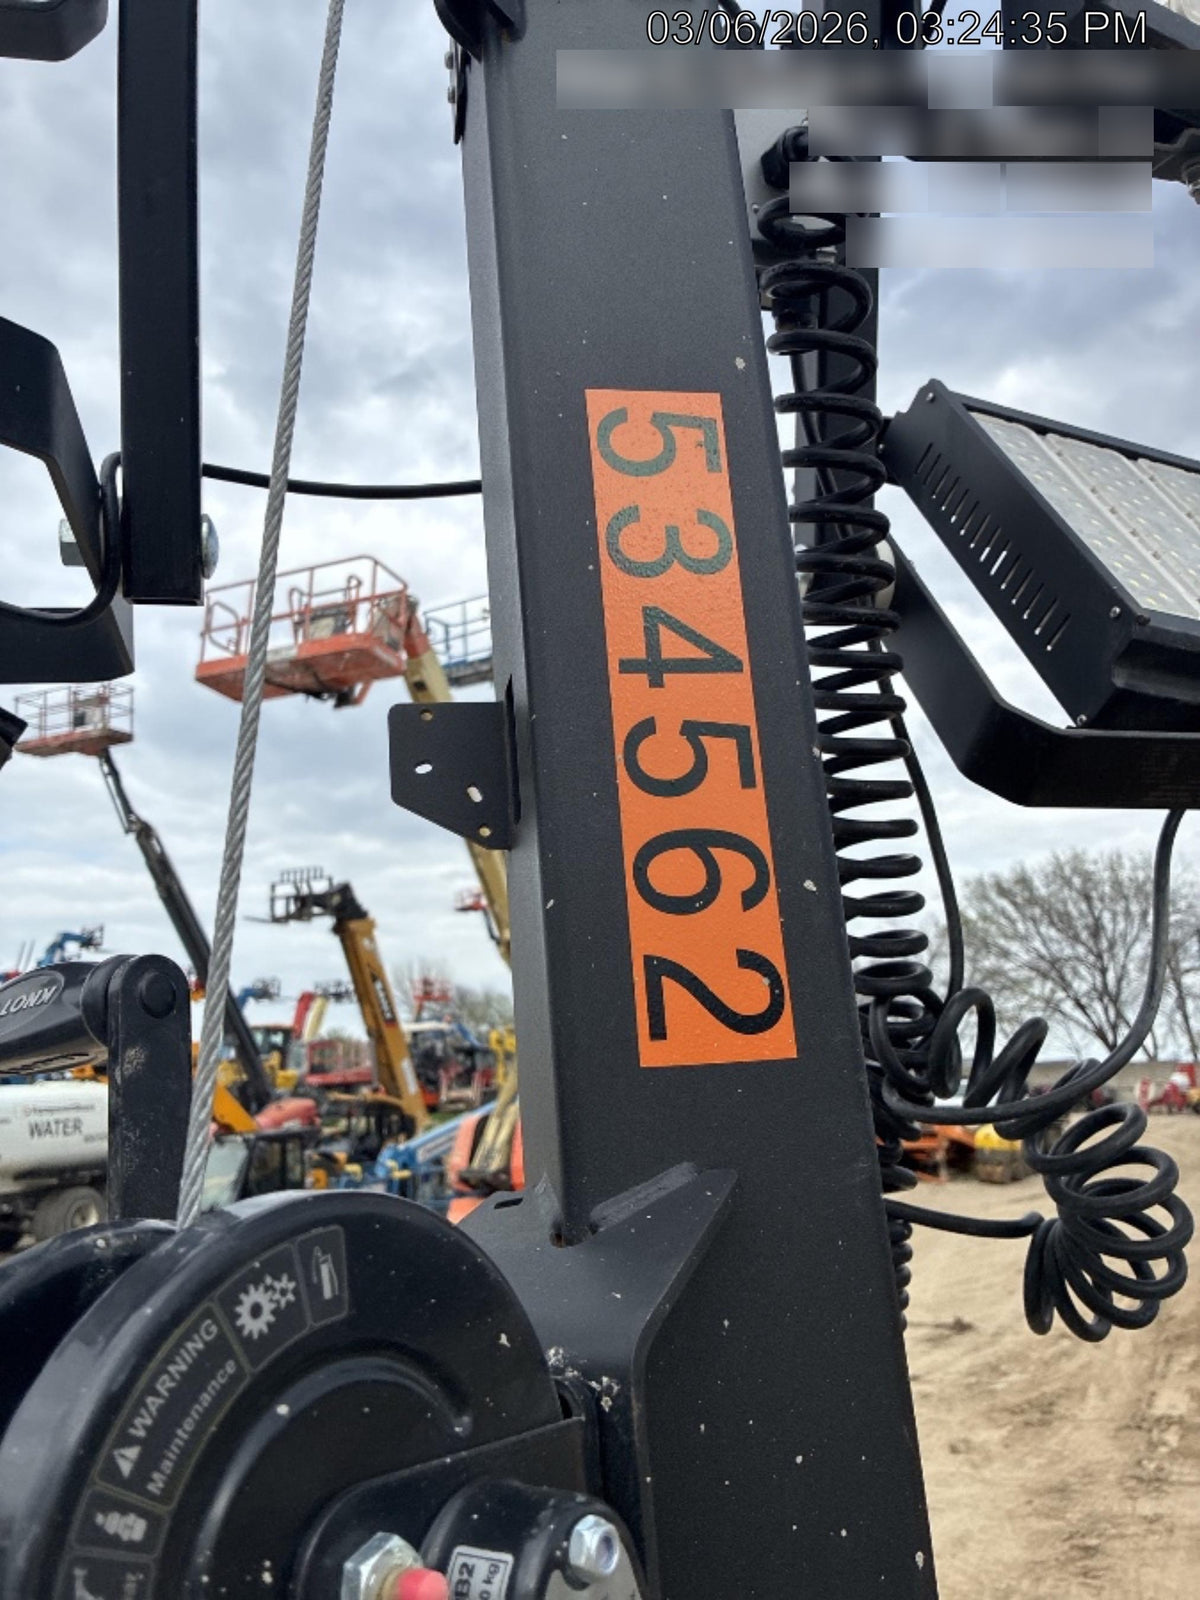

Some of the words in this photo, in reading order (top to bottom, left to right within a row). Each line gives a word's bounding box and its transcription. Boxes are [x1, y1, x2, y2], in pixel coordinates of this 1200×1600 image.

[597, 404, 786, 1042] 534562
[28, 1116, 84, 1139] WATER
[128, 1319, 218, 1438] WARNING
[146, 1359, 236, 1496] Maintenance
[482, 1563, 500, 1584] kg
